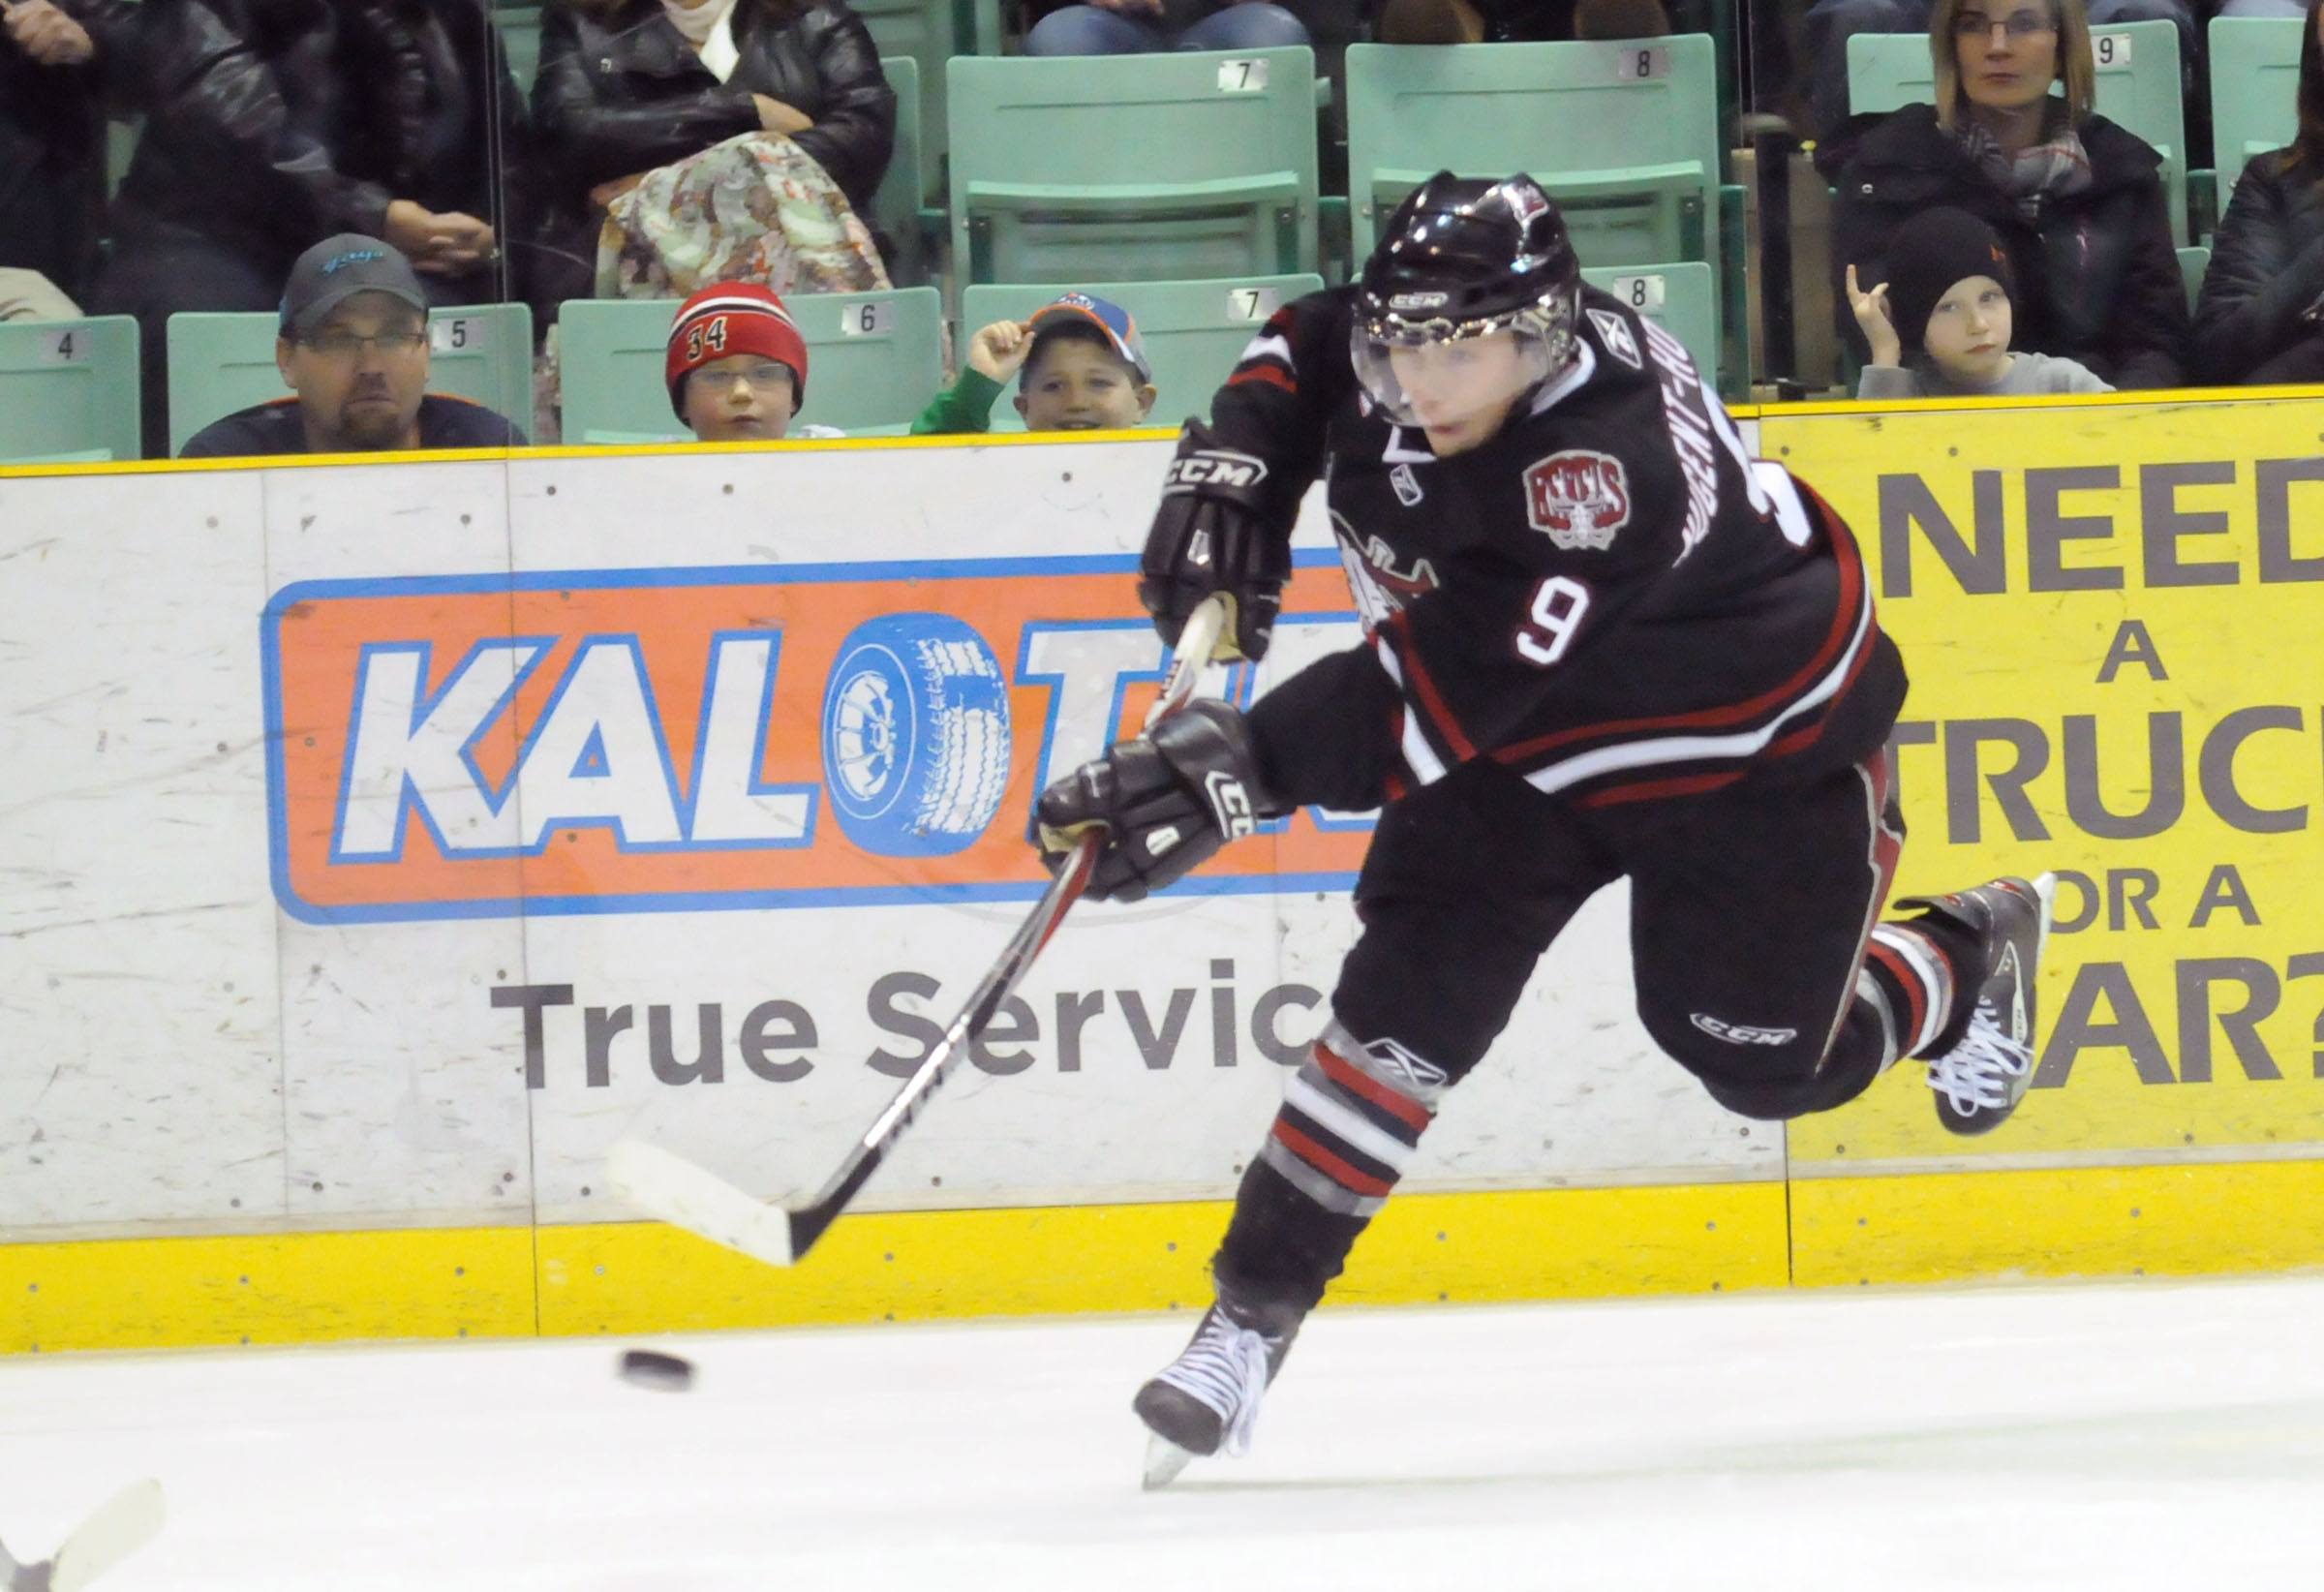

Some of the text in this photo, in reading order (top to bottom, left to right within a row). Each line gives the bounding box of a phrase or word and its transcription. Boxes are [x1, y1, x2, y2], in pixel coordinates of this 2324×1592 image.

[1636, 49, 1652, 78] 8
[2099, 37, 2113, 64] 9
[1238, 62, 1251, 88] 7
[1246, 291, 1260, 319] 7
[1632, 279, 1645, 307] 8
[860, 303, 875, 333] 6
[56, 331, 74, 360] 4
[451, 319, 466, 349] 5
[687, 317, 728, 363] 34
[1516, 575, 1590, 665] 9
[2095, 620, 2170, 684] A
[1885, 706, 2324, 844] RUC
[1218, 781, 1257, 844] CC
[2047, 864, 2263, 933] OR A
[489, 957, 1325, 1090] True Servic
[1699, 1015, 1787, 1046] CCM
[2024, 951, 2324, 1090] AR
